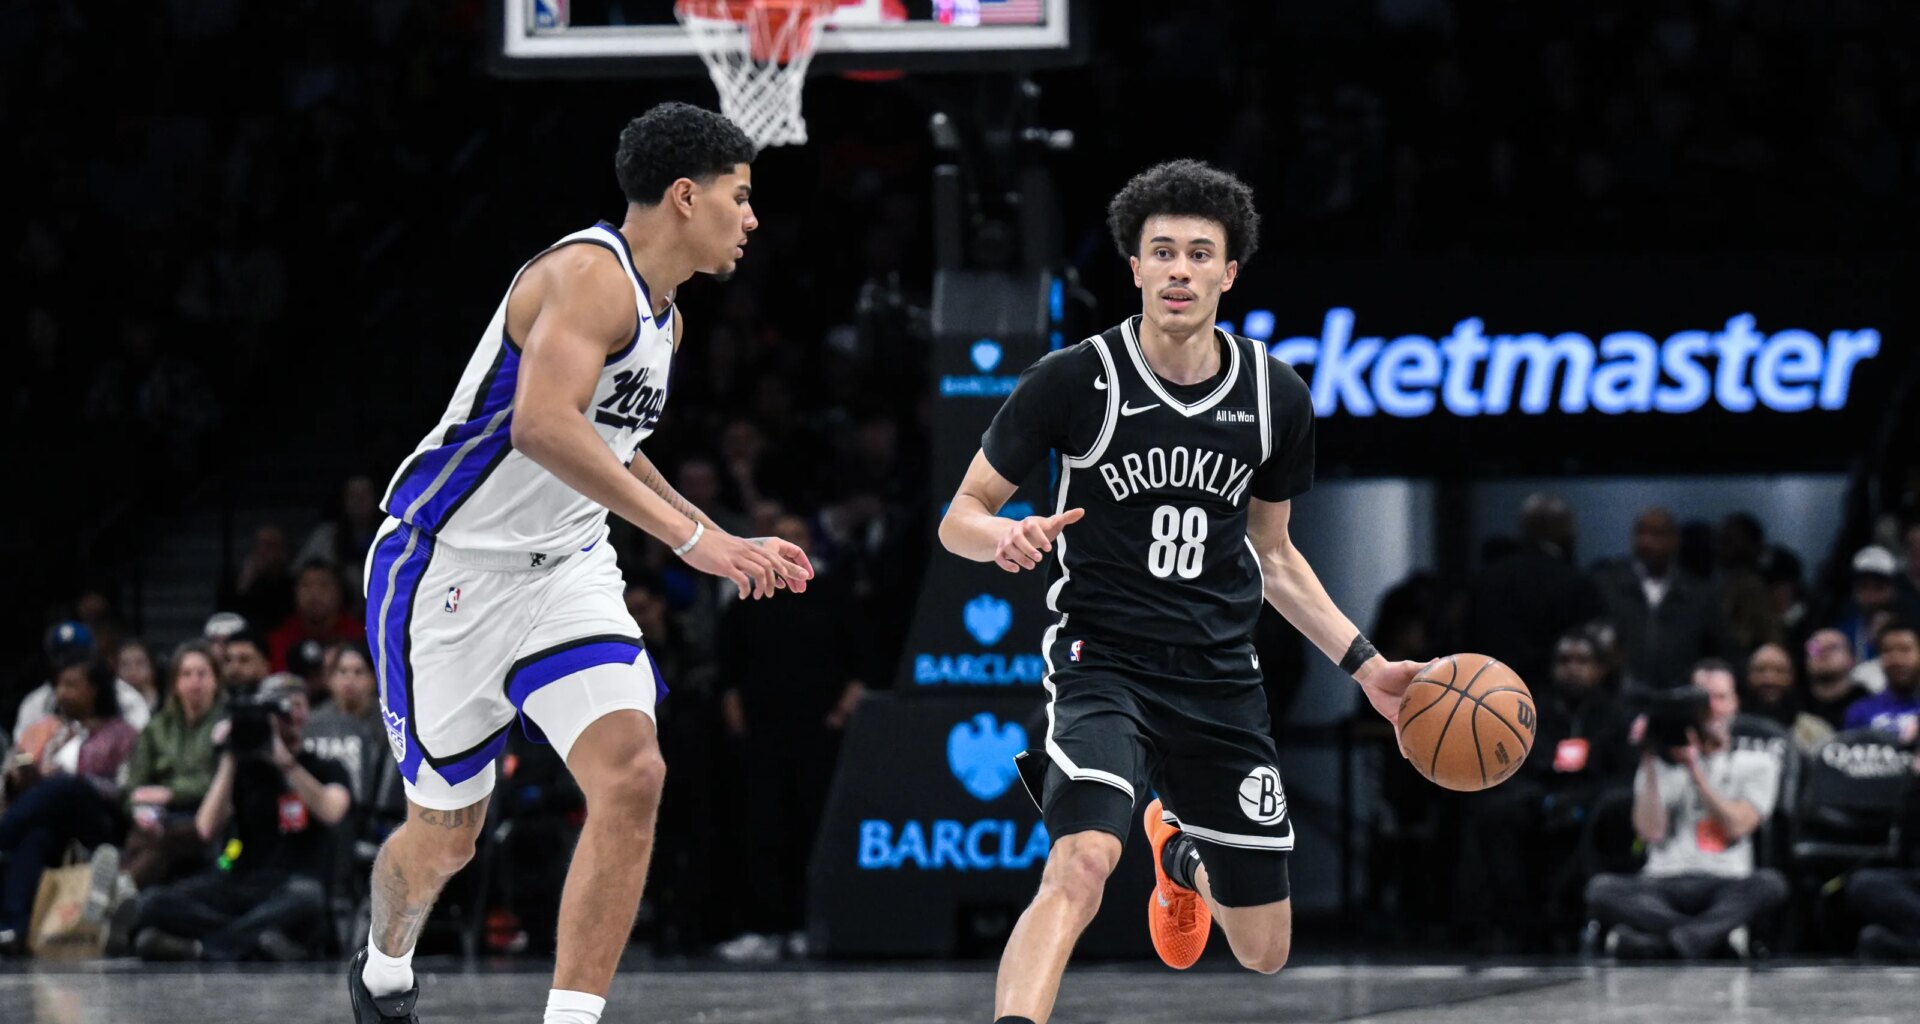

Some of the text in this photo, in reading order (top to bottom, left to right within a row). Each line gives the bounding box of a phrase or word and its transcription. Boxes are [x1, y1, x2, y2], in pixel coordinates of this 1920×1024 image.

[1216, 307, 1880, 417] ketmaster
[597, 366, 664, 434] King
[1216, 410, 1255, 423] All In Won
[1099, 446, 1254, 508] BROOKLYN
[1148, 504, 1208, 579] 88
[914, 653, 1046, 686] BARCLAY
[858, 818, 1050, 870] BARCLA
